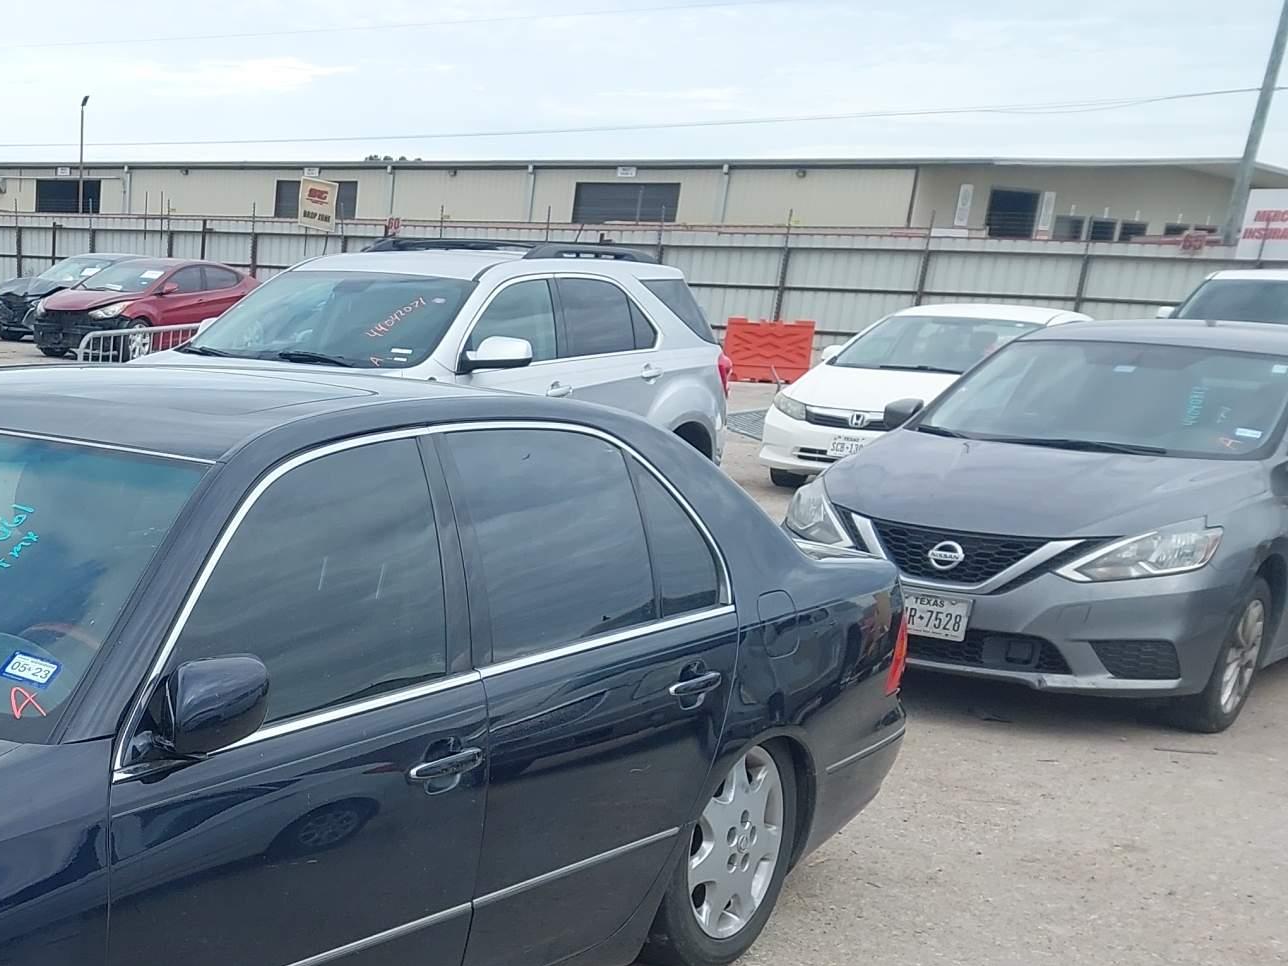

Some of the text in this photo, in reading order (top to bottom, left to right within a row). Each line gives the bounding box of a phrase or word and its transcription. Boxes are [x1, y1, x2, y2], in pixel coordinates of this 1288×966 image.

[303, 209, 331, 223] DROP ZONE
[930, 551, 960, 560] NISSAN
[914, 596, 945, 608] TEXAS
